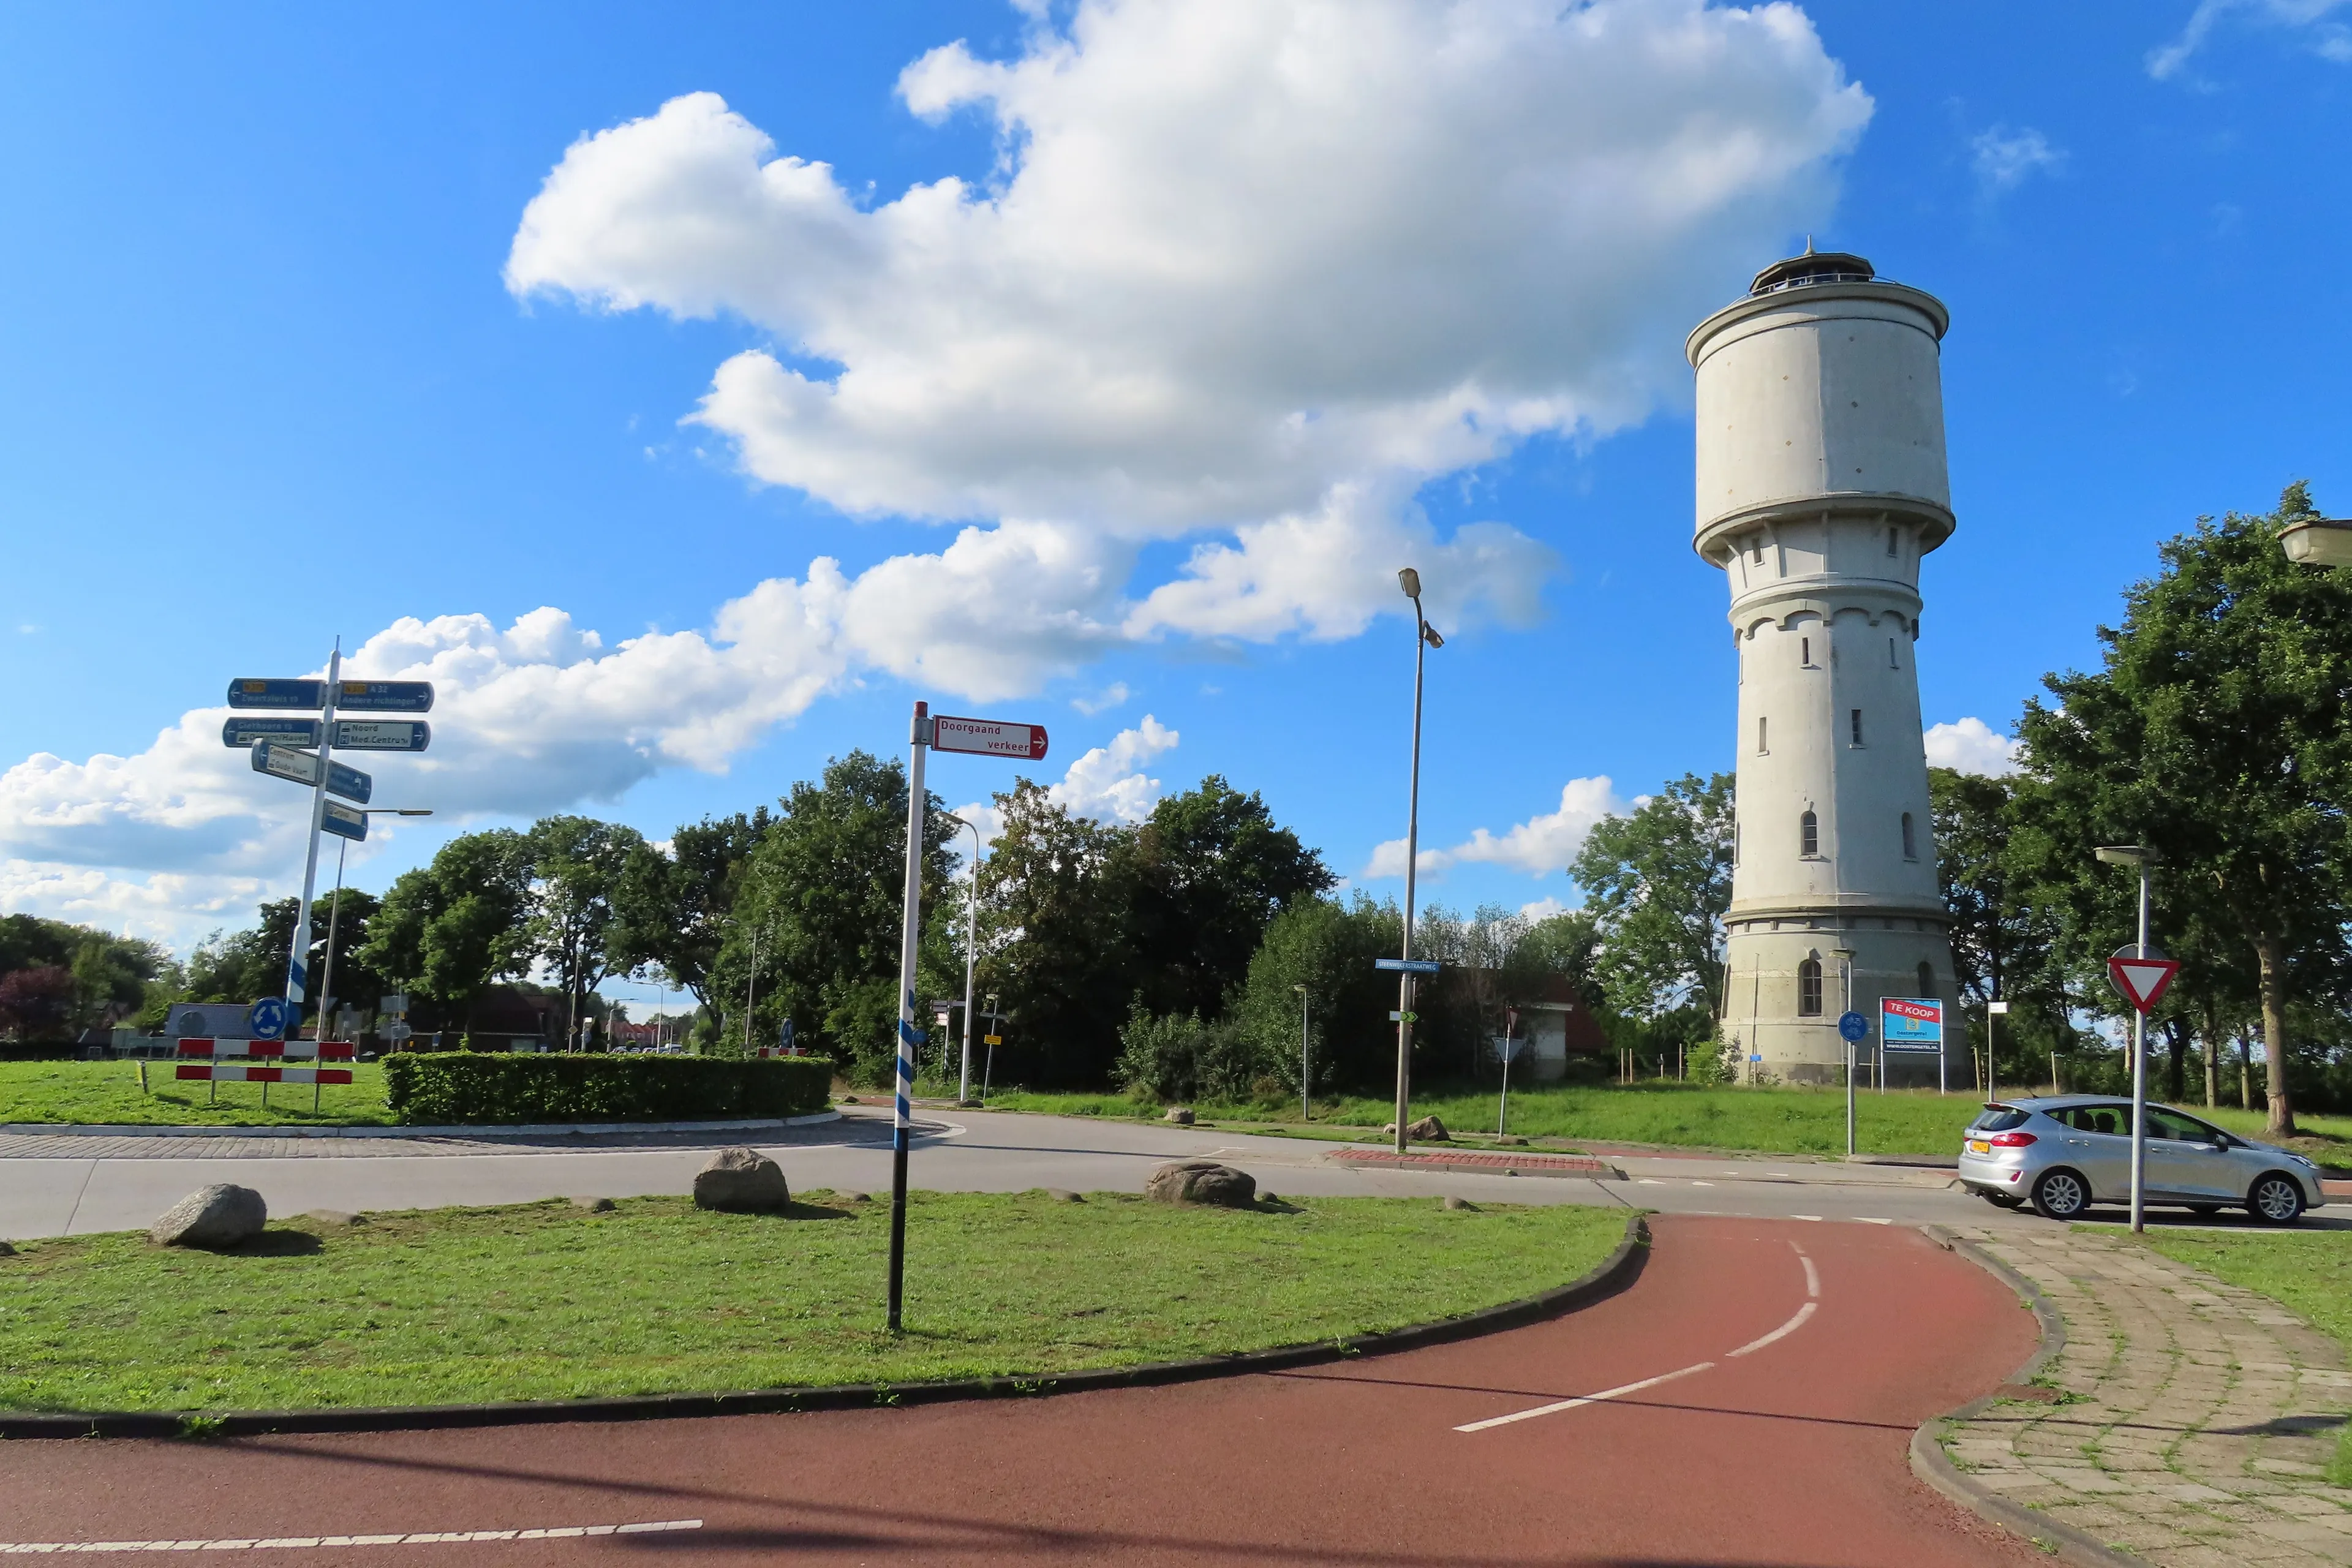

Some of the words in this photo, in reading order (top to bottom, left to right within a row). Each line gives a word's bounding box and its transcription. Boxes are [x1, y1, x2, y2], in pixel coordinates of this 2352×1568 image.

[941, 720, 1001, 735] Doorgaand
[987, 741, 1029, 752] verkeer
[270, 747, 295, 761] Centrum
[1378, 961, 1436, 971] STEENWIJKERSTRAATWEG
[1890, 1003, 1903, 1012] TE
[1905, 1006, 1934, 1018] KOOP
